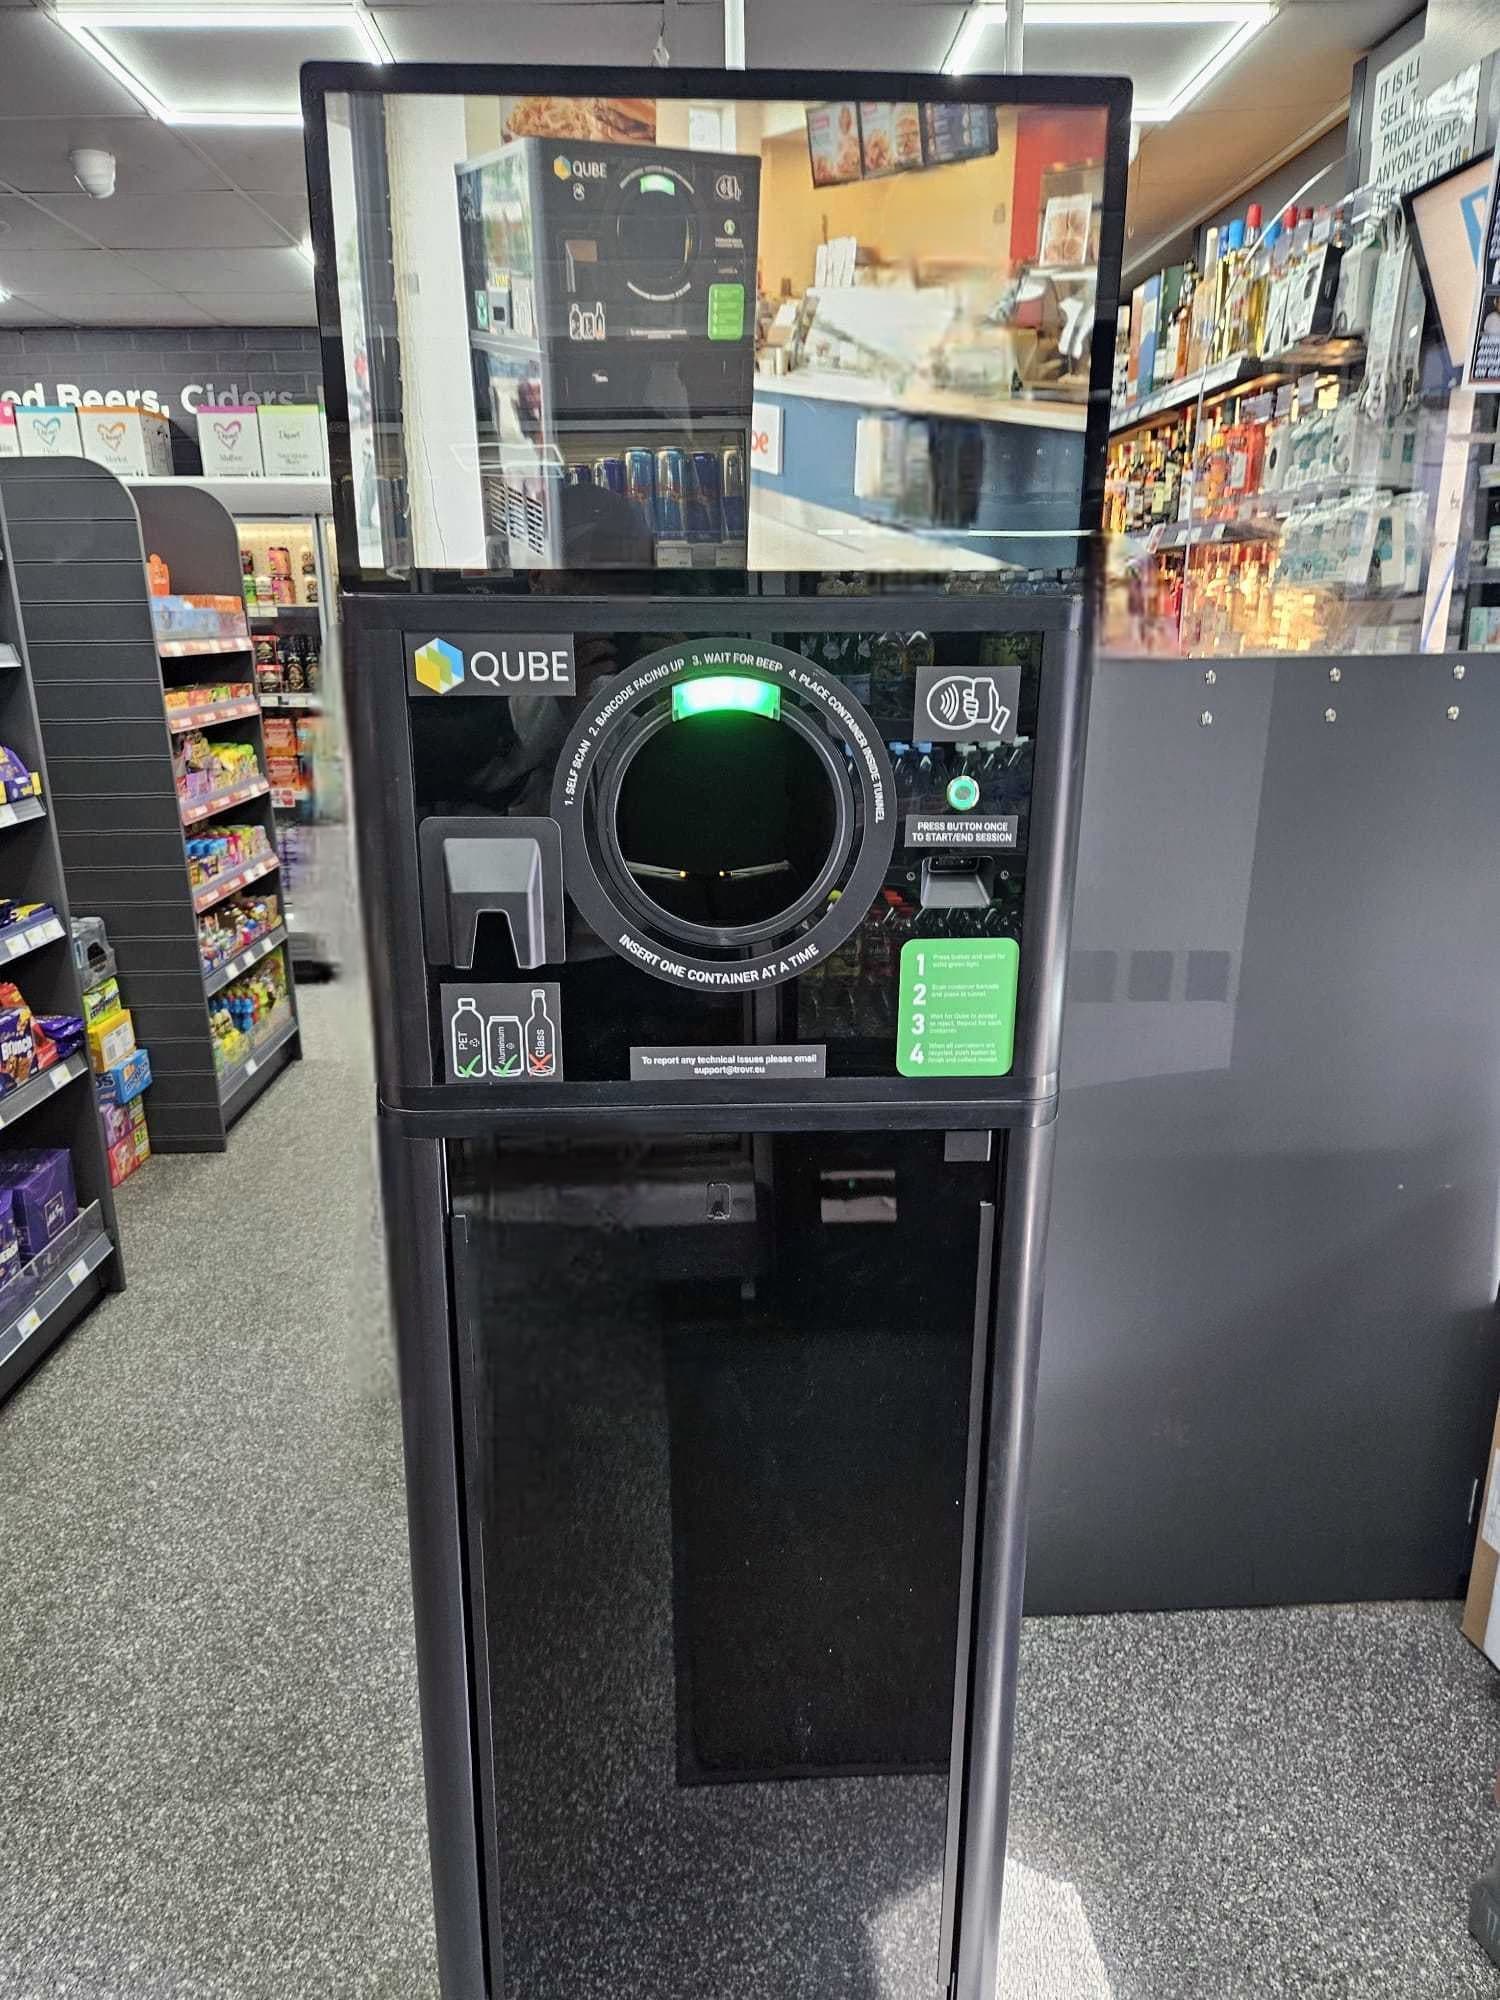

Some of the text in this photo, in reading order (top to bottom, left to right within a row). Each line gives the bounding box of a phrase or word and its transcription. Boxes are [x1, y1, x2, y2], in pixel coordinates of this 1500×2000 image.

[1379, 80, 1389, 105] IT
[1392, 74, 1403, 92] IS
[1380, 95, 1406, 131] SELL
[572, 160, 607, 178] QUBE
[1376, 141, 1421, 185] ANYONE
[1401, 168, 1424, 194] AGE
[1427, 157, 1445, 183] OF
[470, 651, 569, 687] QUBE
[566, 769, 578, 794] SELF
[573, 739, 592, 768] SCAN
[589, 727, 600, 737] 2.
[595, 685, 635, 727] BARCODE
[634, 664, 669, 691] FACING
[671, 658, 685, 671] UP
[692, 655, 702, 666] 3.
[704, 653, 731, 665] WAIT
[733, 653, 755, 665] FOR
[756, 656, 783, 673] BEEP
[788, 668, 798, 681] 4.
[799, 673, 830, 701] PLACE
[828, 696, 868, 748] CONTAINER
[862, 746, 881, 782] INSIDE
[873, 779, 885, 824] TUNNEL
[912, 833, 1012, 842] TO START/END SESSION
[918, 822, 1008, 831] PRESS BUTTON ONCE
[618, 934, 820, 985] INSERT ONE CONTAINER AT A TIME
[917, 953, 925, 977] 1
[912, 983, 927, 1006] 2
[911, 1013, 925, 1035] 3
[458, 1032, 468, 1050] PET
[497, 1026, 506, 1065] Aluminium
[534, 1029, 545, 1057] Glass
[909, 1042, 924, 1064] 4
[641, 1056, 652, 1065] To
[654, 1057, 679, 1066] report
[681, 1057, 696, 1066] any
[697, 1055, 735, 1064] technical
[766, 1055, 793, 1065] please
[794, 1054, 817, 1063] email
[694, 1066, 765, 1075] support@trovr.eu
